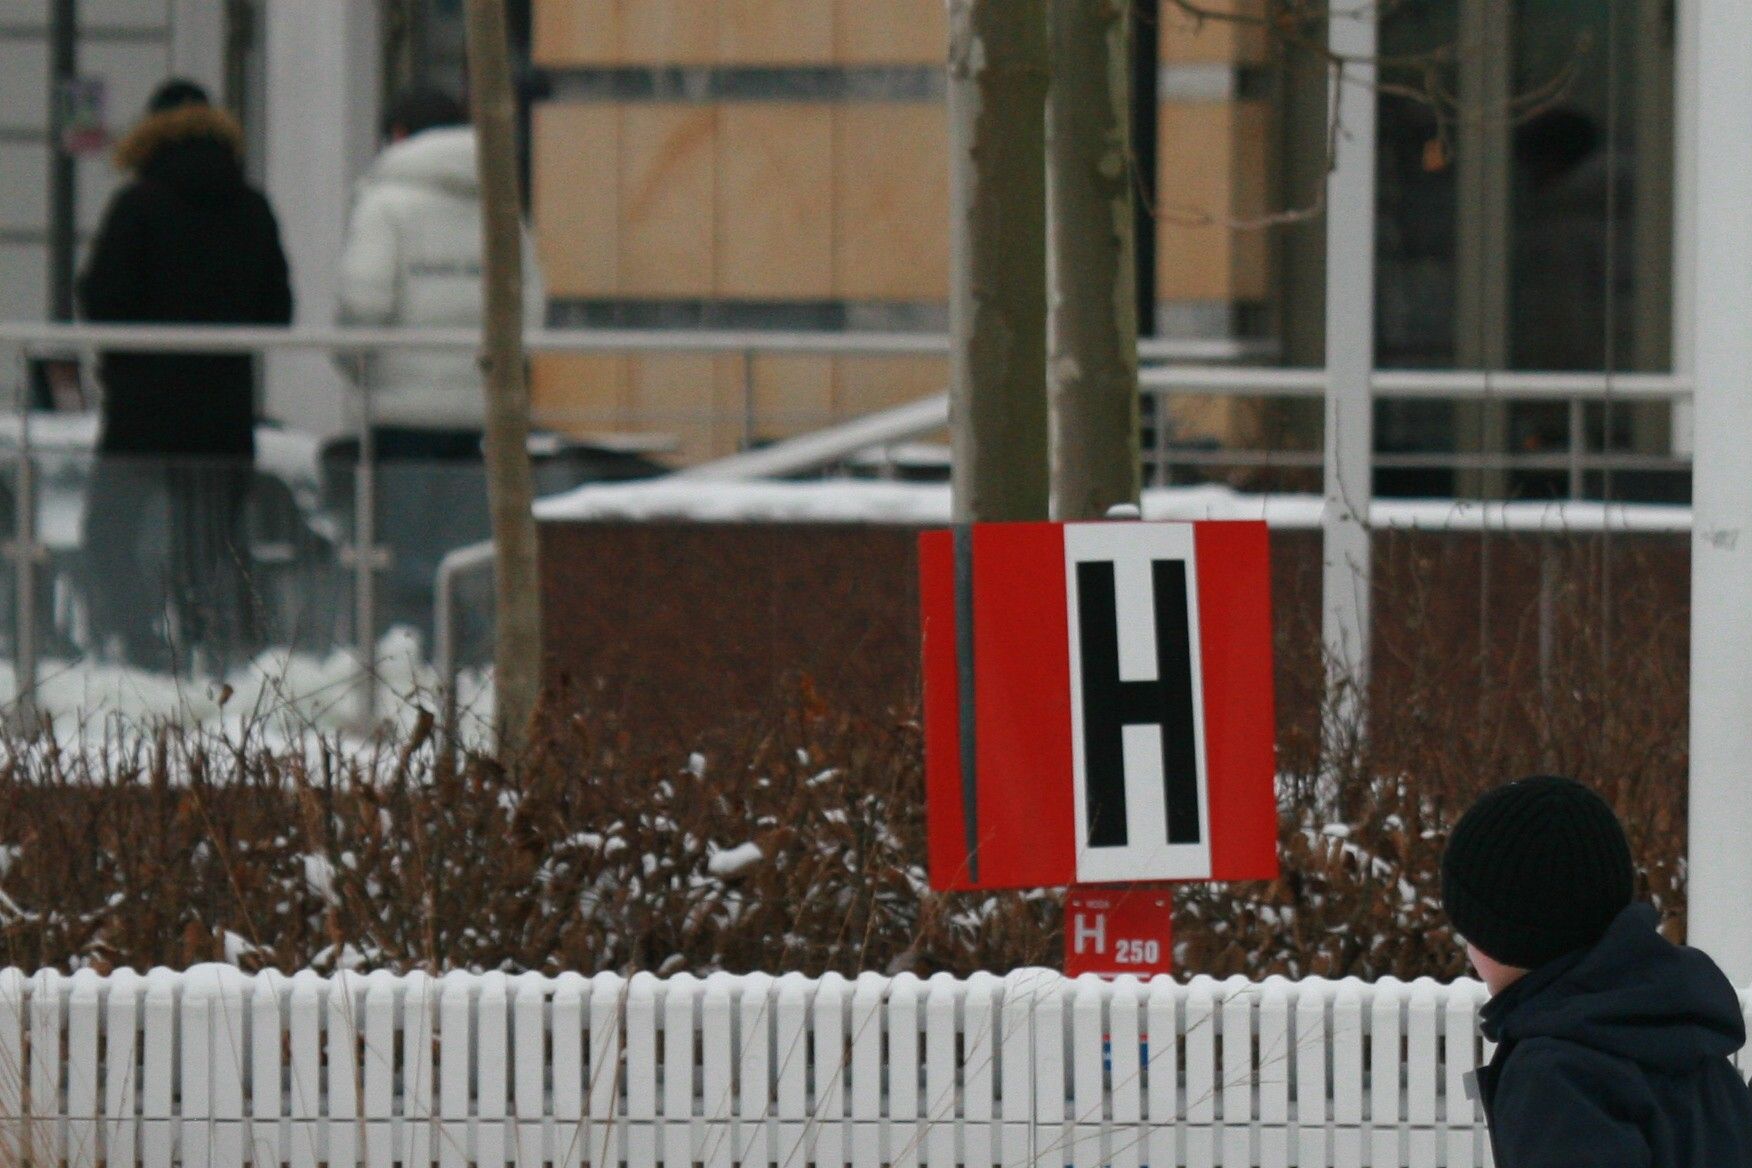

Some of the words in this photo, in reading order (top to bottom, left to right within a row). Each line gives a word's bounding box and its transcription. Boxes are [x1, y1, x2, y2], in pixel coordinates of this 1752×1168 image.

[1075, 559, 1201, 848] H
[1074, 913, 1105, 954] H
[1115, 939, 1159, 964] 250
